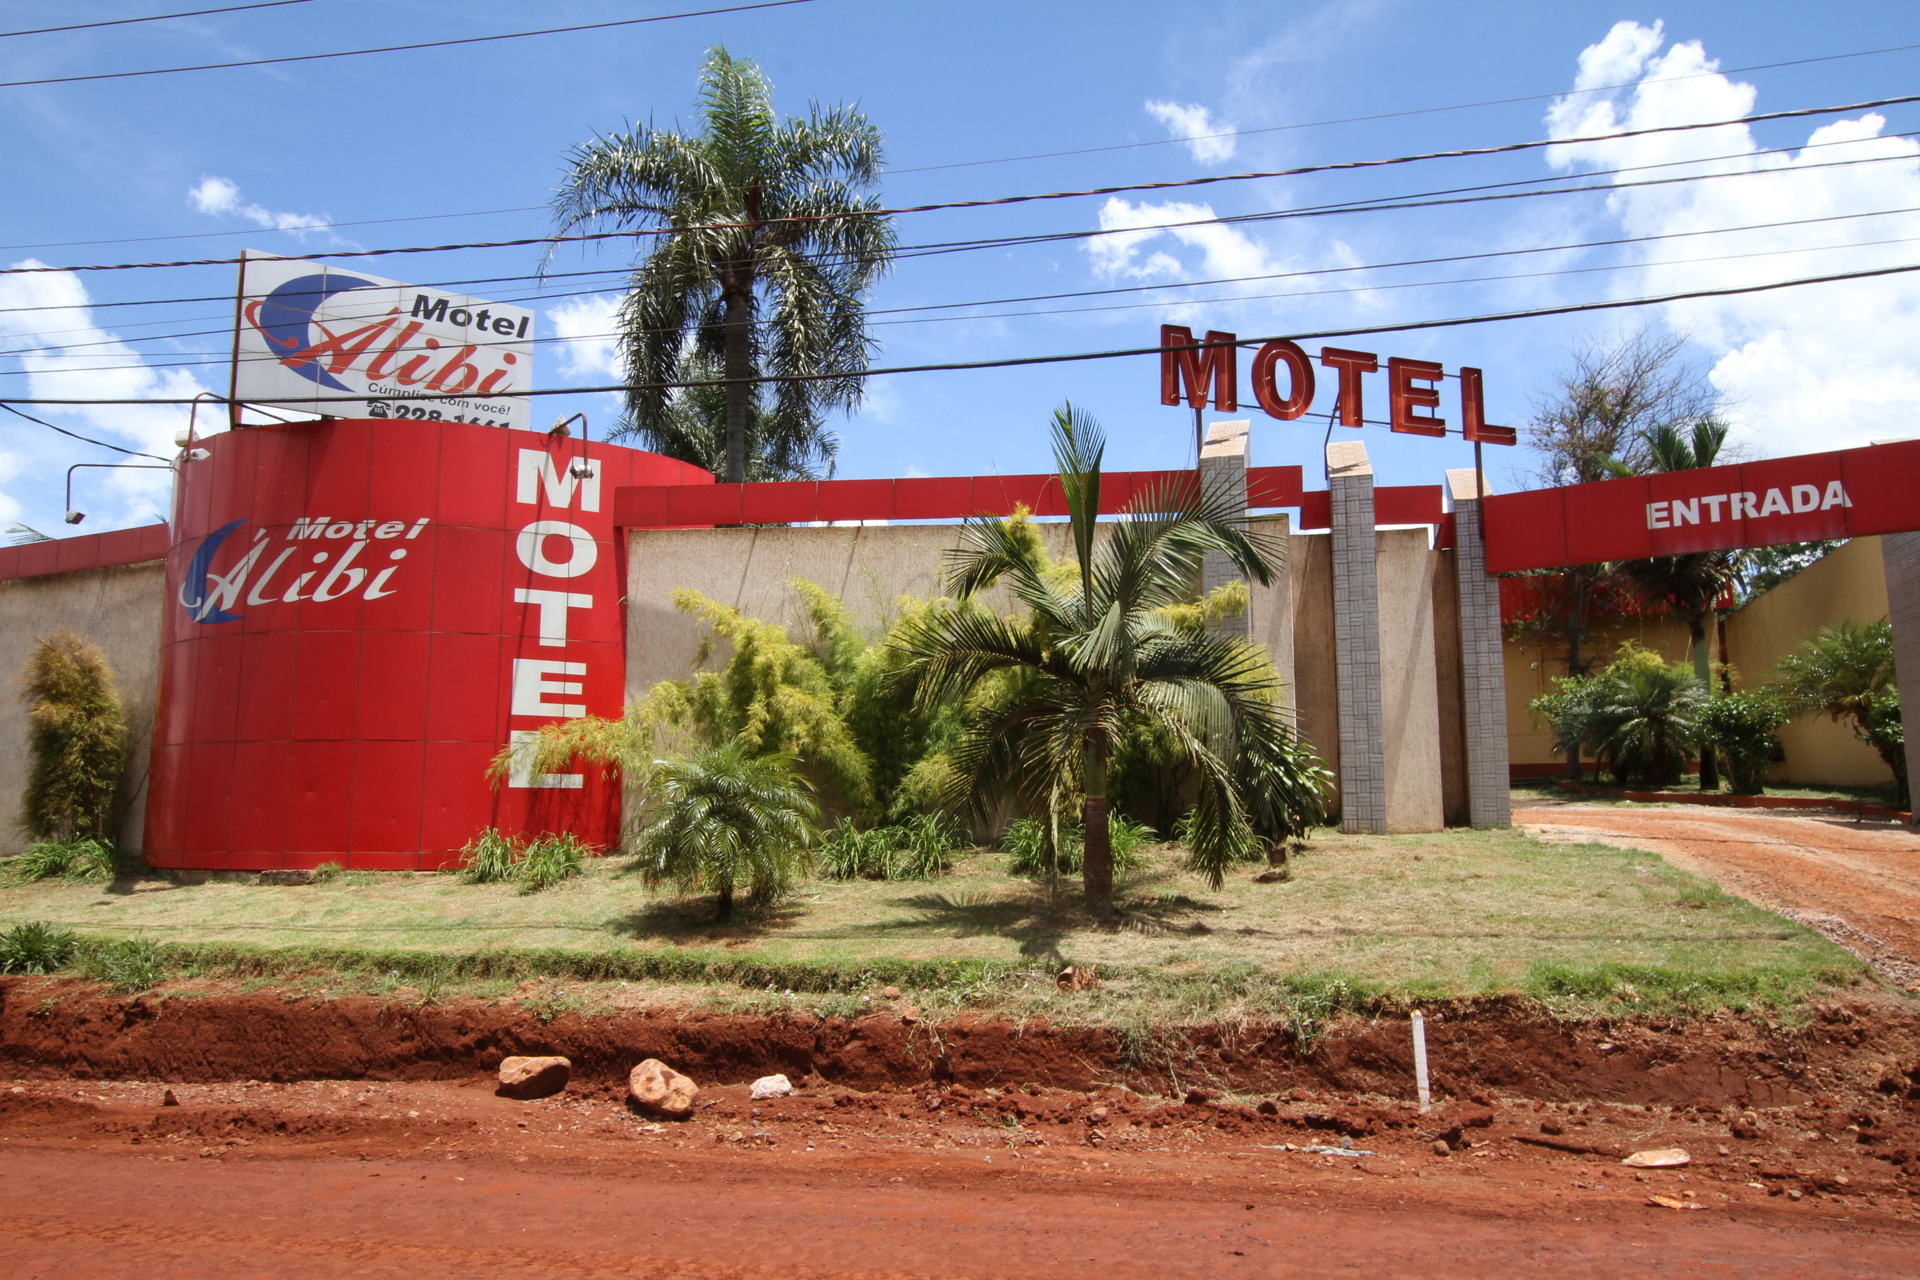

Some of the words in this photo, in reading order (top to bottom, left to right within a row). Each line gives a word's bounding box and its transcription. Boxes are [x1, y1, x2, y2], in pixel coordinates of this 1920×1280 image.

[410, 294, 530, 339] Motel
[439, 397, 470, 409] com
[474, 401, 511, 416] você!
[1160, 324, 1517, 446] MOTEL
[286, 516, 430, 541] Motel
[1646, 480, 1853, 530] ENTRADA
[508, 448, 602, 789] MOTEL
